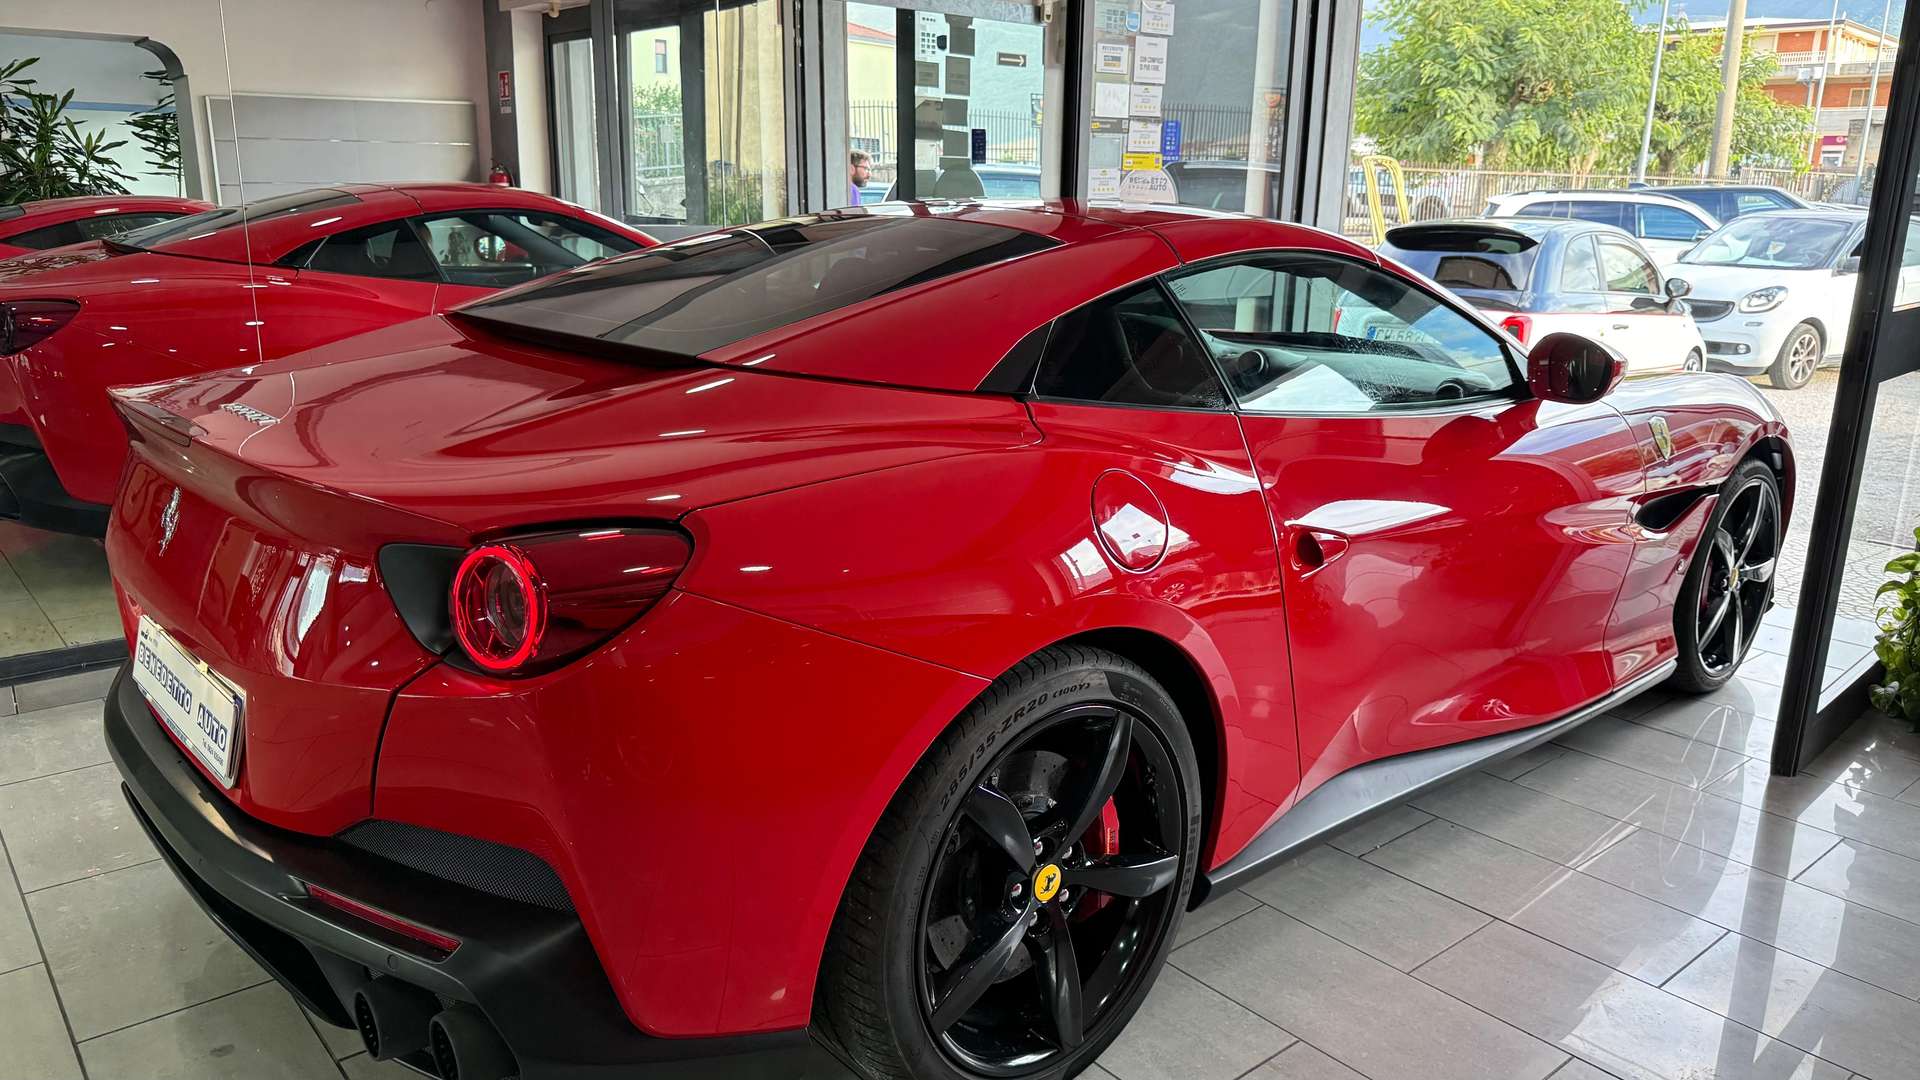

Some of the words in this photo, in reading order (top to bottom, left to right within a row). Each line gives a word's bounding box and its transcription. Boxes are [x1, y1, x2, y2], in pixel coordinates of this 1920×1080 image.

[1129, 176, 1168, 185] BEETTO
[138, 641, 193, 715] BENEDETTO
[196, 702, 228, 752] AUTO
